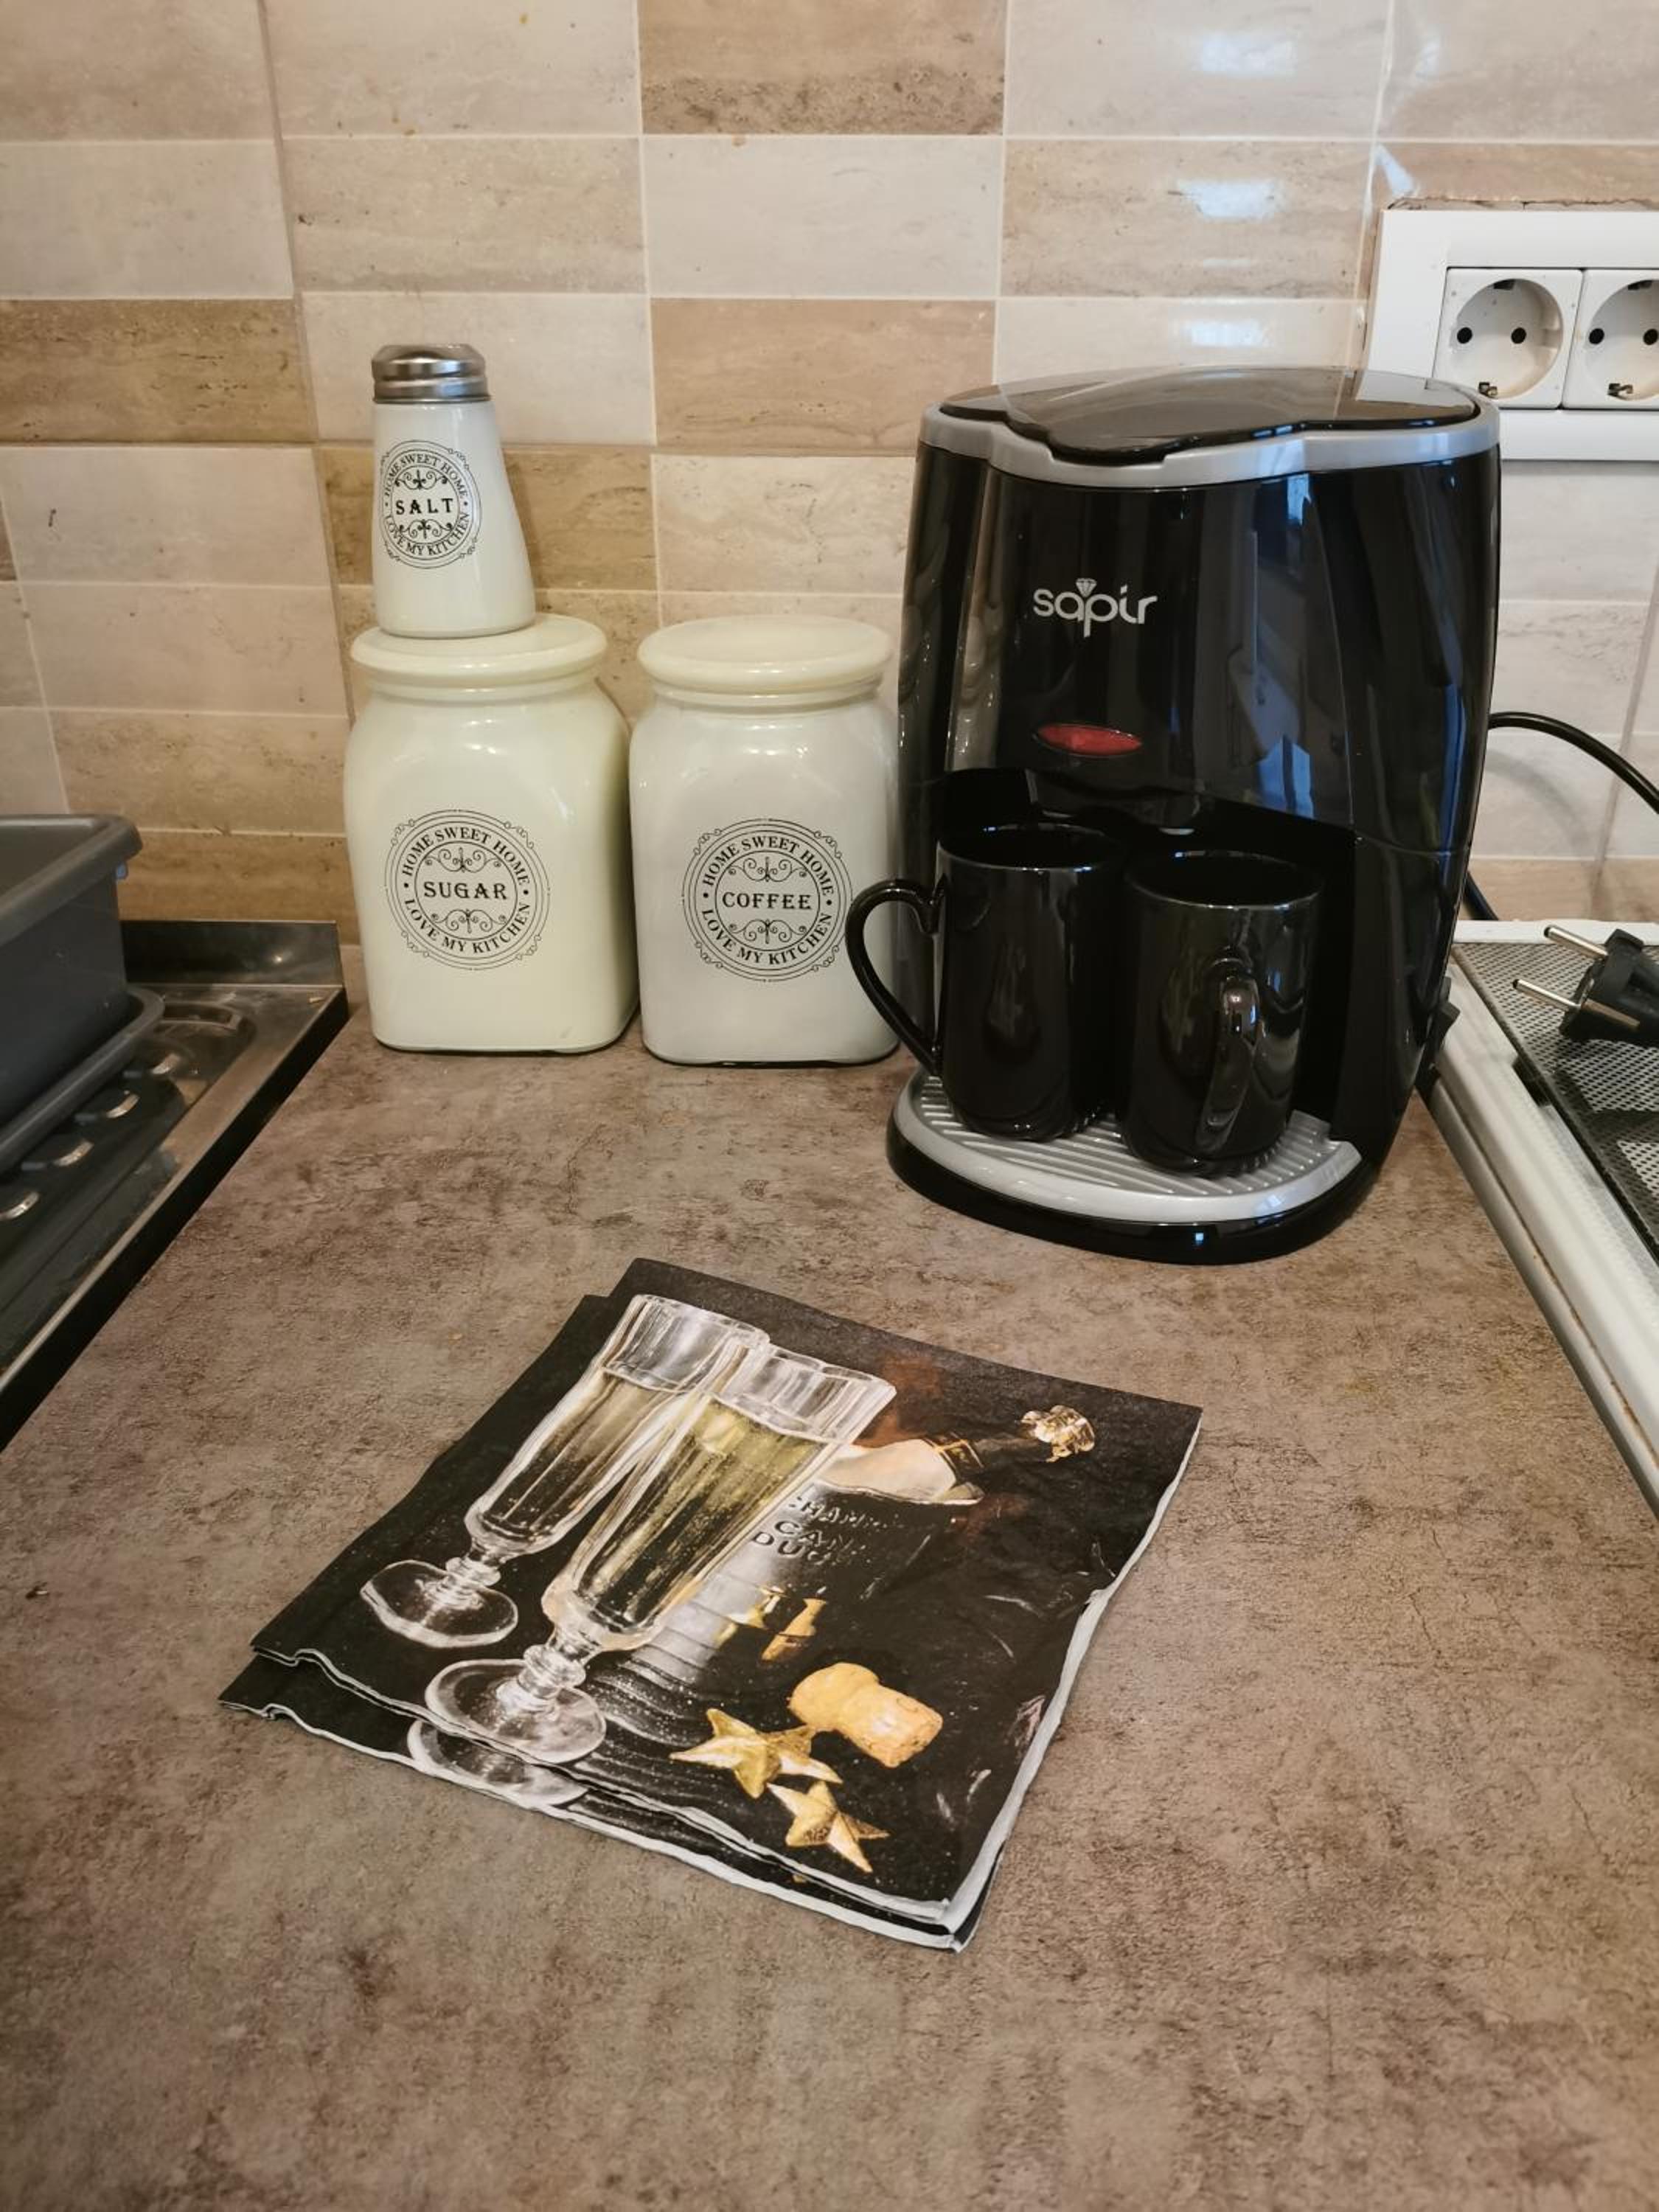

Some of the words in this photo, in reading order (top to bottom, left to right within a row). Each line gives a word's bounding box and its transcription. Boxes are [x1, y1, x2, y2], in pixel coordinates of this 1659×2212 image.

[385, 462, 400, 497] HOME
[401, 453, 440, 467] SWEET
[440, 462, 468, 497] HOME
[395, 498, 453, 515] SALT
[384, 515, 405, 547] LOVE
[406, 543, 425, 555] MY
[428, 512, 470, 555] KITCHEN
[1033, 579, 1158, 638] sapir
[402, 835, 434, 876] HOME
[434, 827, 492, 844] SWEET
[493, 841, 530, 886] HOME
[702, 844, 740, 886] HOME
[741, 835, 800, 854] SWEET
[800, 849, 835, 897] HOME
[423, 881, 507, 900] SUGAR
[722, 891, 813, 910] COFFEE
[404, 898, 440, 941] LOVE
[442, 936, 467, 952] MY
[472, 902, 531, 954] KITCHEN
[701, 908, 737, 952] LOVE
[737, 947, 763, 963] MY
[768, 913, 832, 965] KITCHEN
